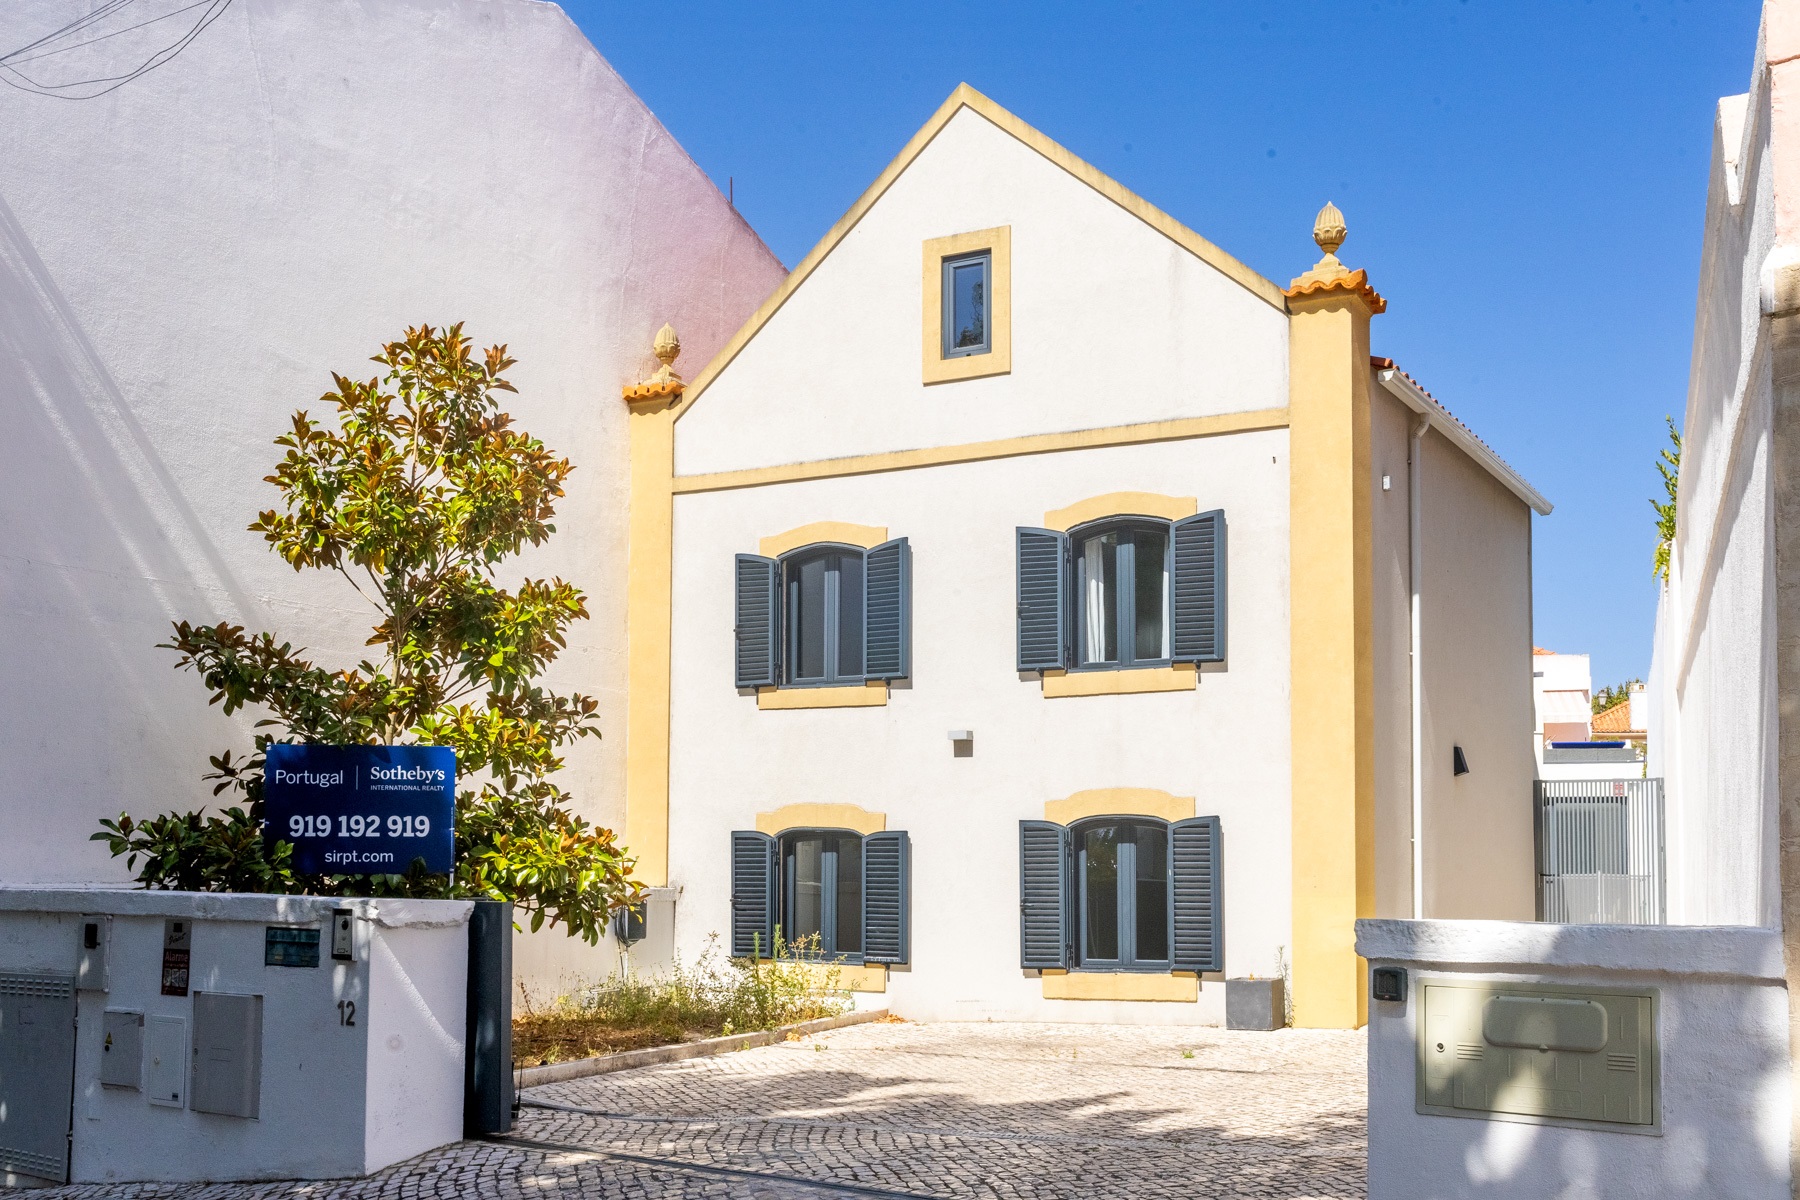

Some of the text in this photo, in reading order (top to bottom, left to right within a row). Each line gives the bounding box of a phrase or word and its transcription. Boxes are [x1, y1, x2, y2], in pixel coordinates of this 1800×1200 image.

[275, 765, 445, 788] Portugal Sotheby's
[289, 815, 430, 837] 919 192 919
[324, 850, 394, 865] sirpt.com
[165, 951, 189, 962] Alarme
[337, 1000, 356, 1026] 12
